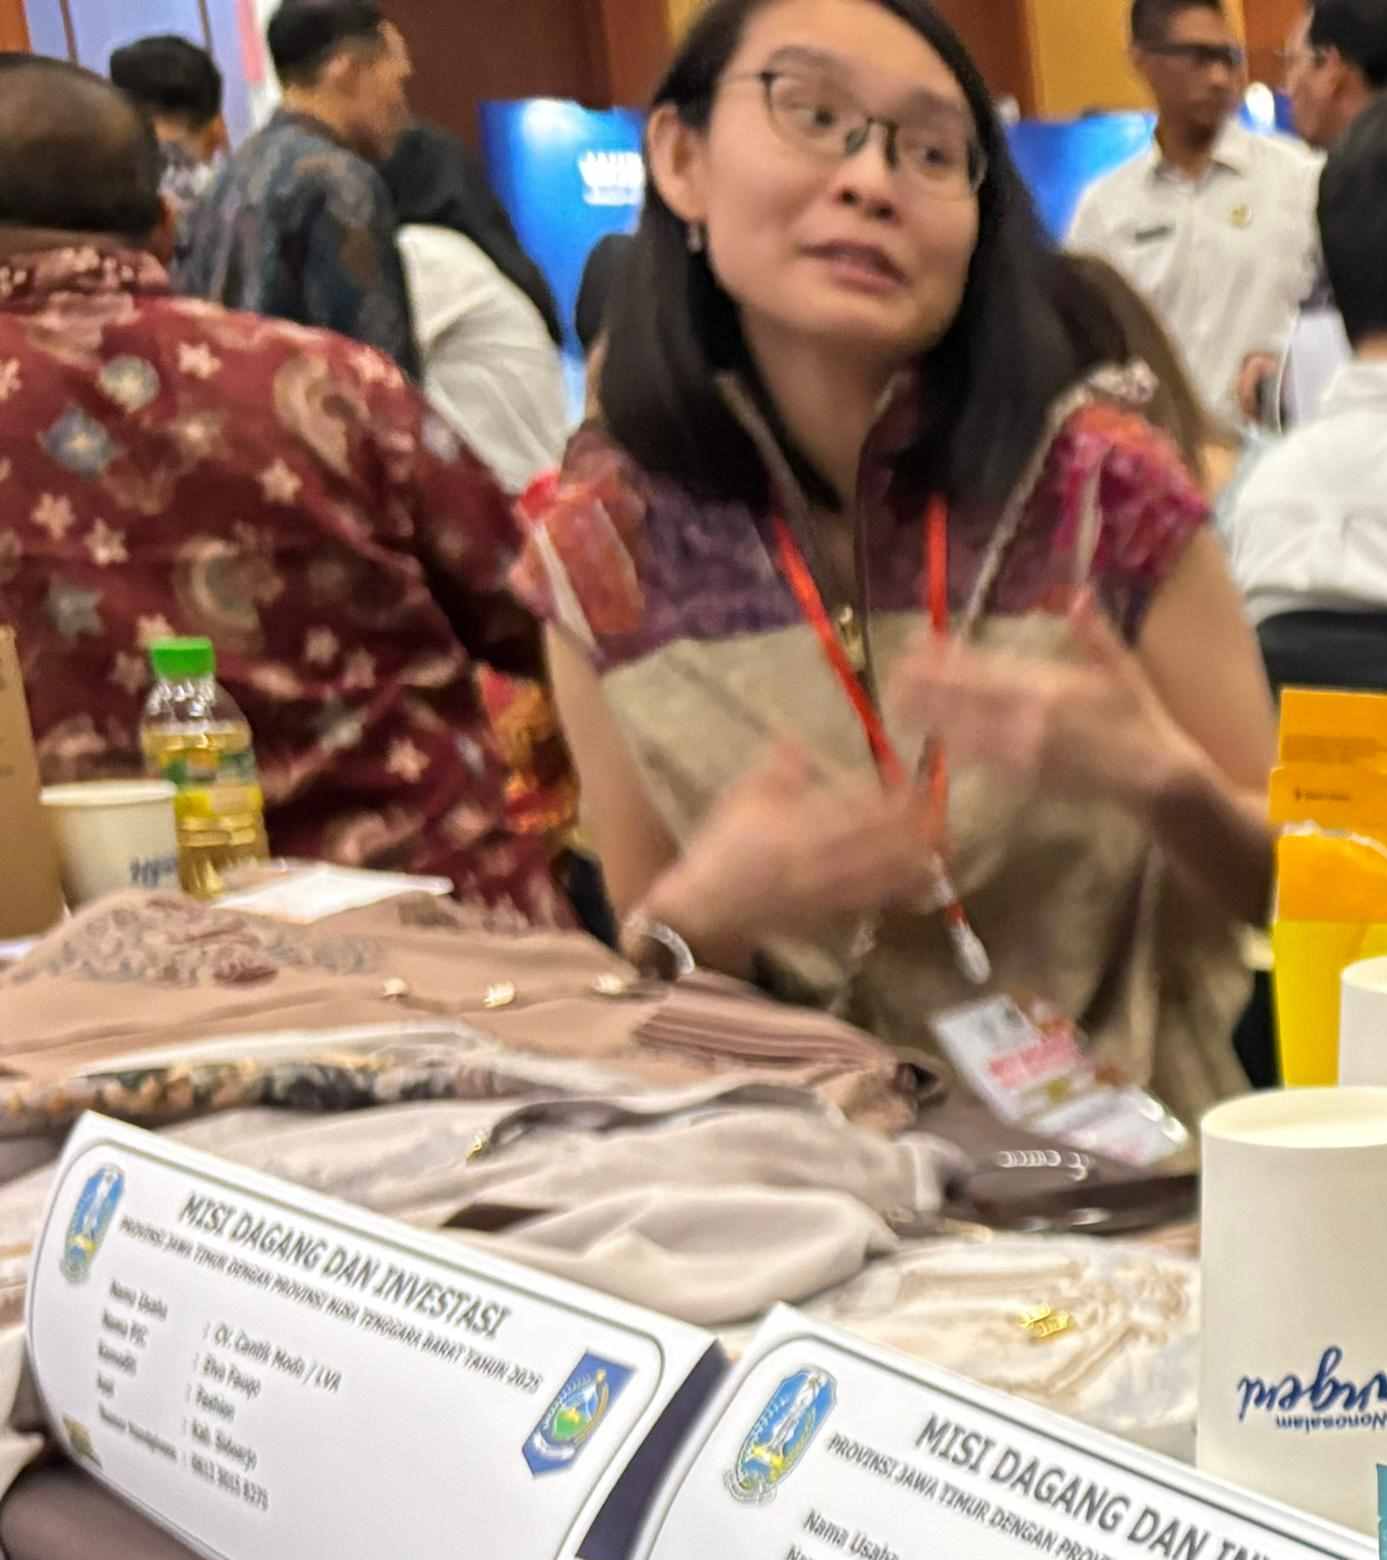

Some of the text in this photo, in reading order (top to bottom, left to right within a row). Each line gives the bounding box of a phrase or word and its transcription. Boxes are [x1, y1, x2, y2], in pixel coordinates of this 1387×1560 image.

[179, 1189, 512, 1340] MISI DAGANG DAN INVESTASI
[271, 1275, 329, 1312] PROVINSI
[463, 1347, 511, 1383] TAHUN
[506, 1364, 544, 1395] 2025
[803, 1507, 850, 1549] Nama
[825, 1432, 900, 1479] PROVINSI
[893, 1464, 940, 1504] JAWA
[938, 1479, 994, 1523] TIMUR
[988, 1506, 1060, 1553] DENGAN
[914, 1411, 996, 1473] MISI
[989, 1445, 1131, 1534] DAGANG
